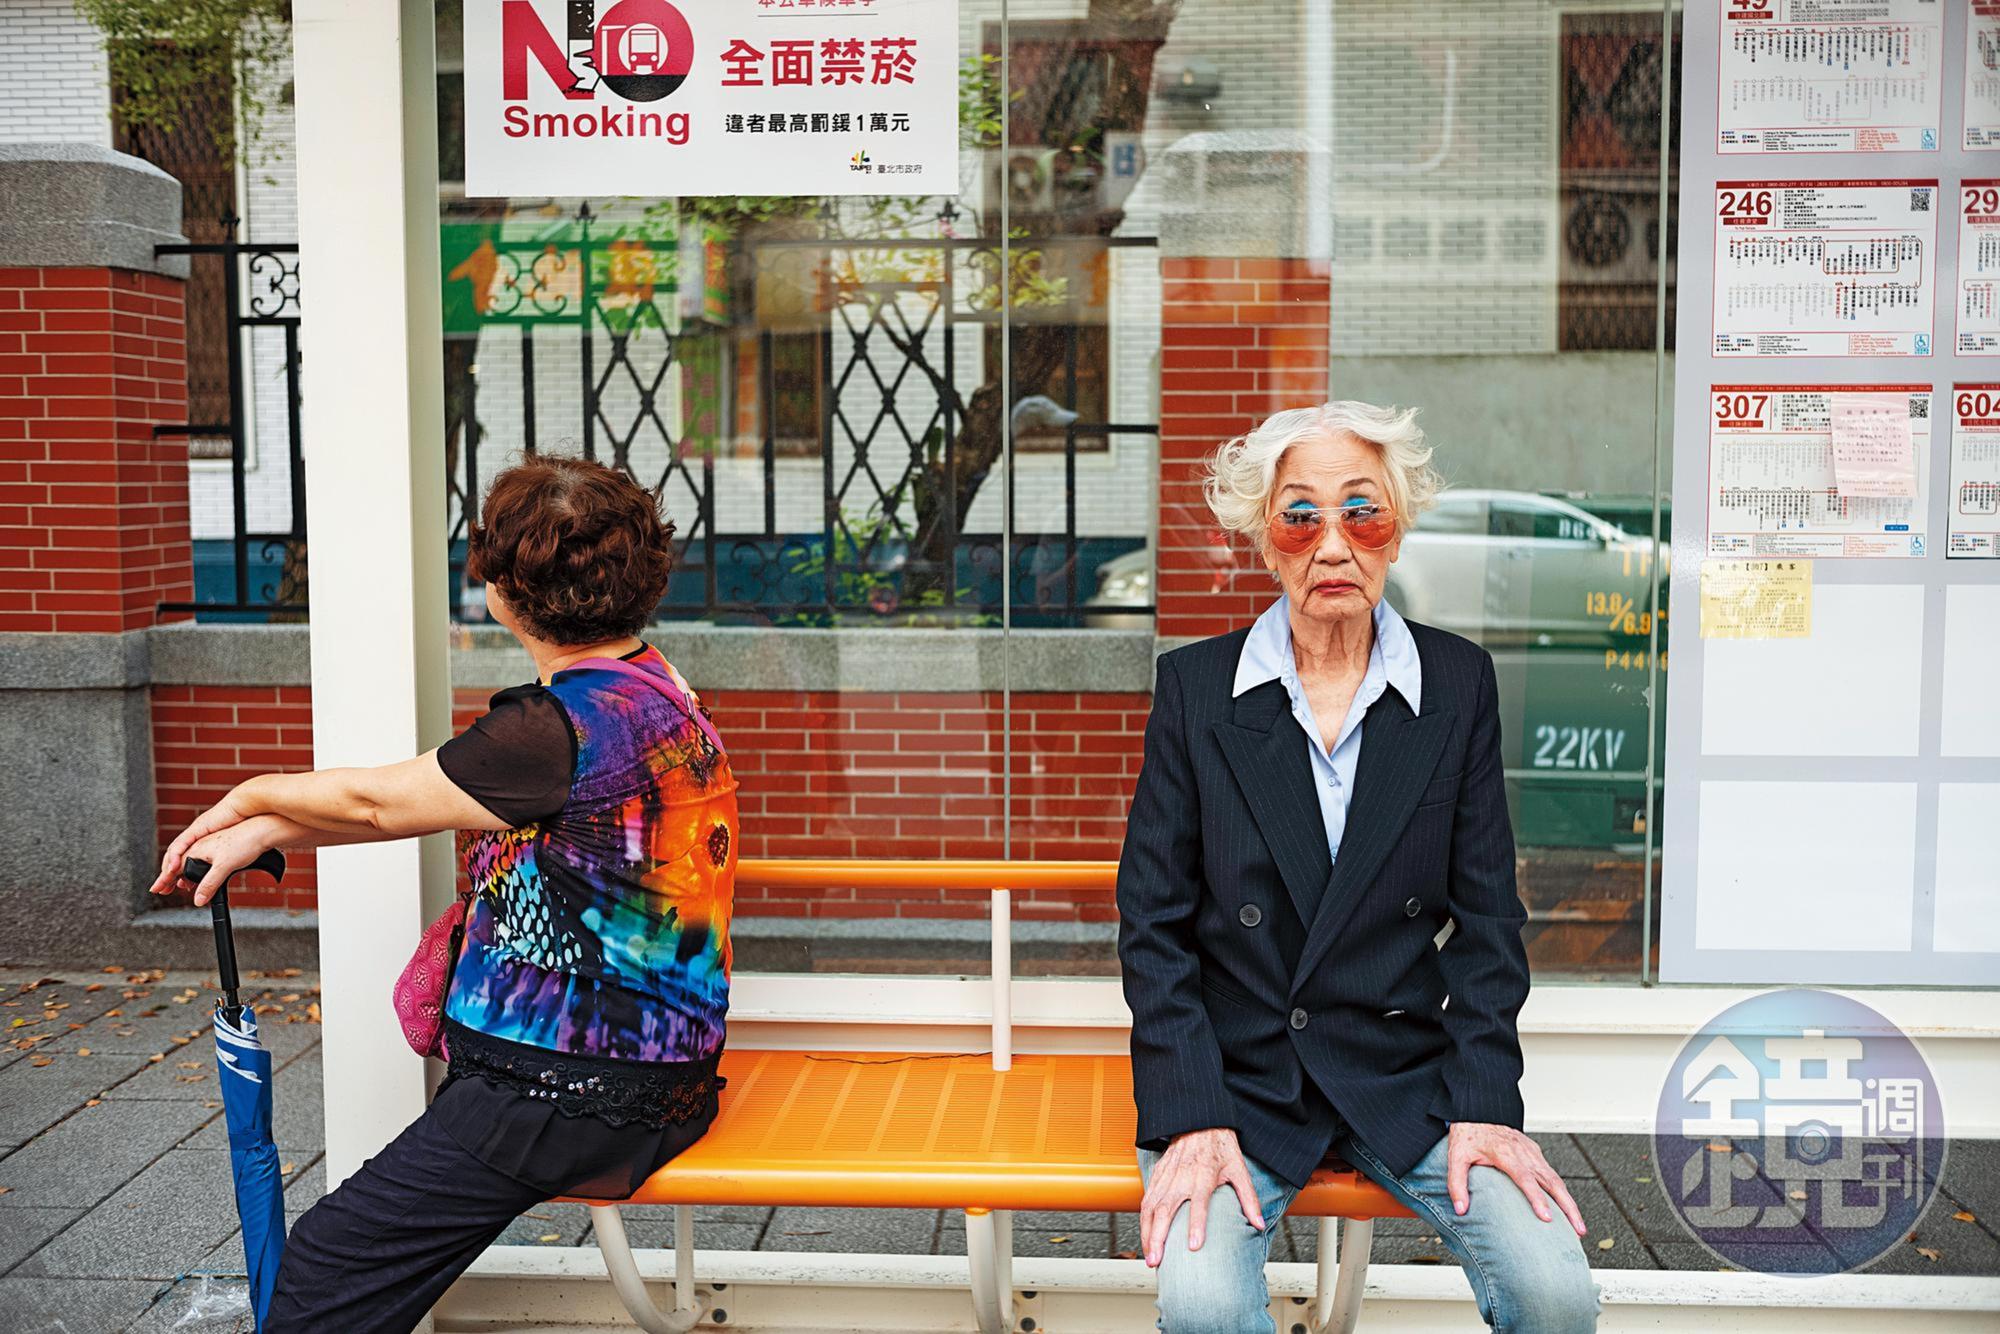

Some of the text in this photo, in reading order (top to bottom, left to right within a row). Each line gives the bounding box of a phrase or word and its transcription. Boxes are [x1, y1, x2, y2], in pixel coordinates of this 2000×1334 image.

[720, 37, 917, 86] 全面禁菸
[503, 106, 690, 145] Smoking
[725, 113, 910, 133] 違者最高罰鍰1萬元
[877, 164, 922, 174] 臺北市政府
[1719, 191, 1772, 216] 246
[1715, 395, 1768, 419] 307
[1534, 726, 1625, 770] 22KV
